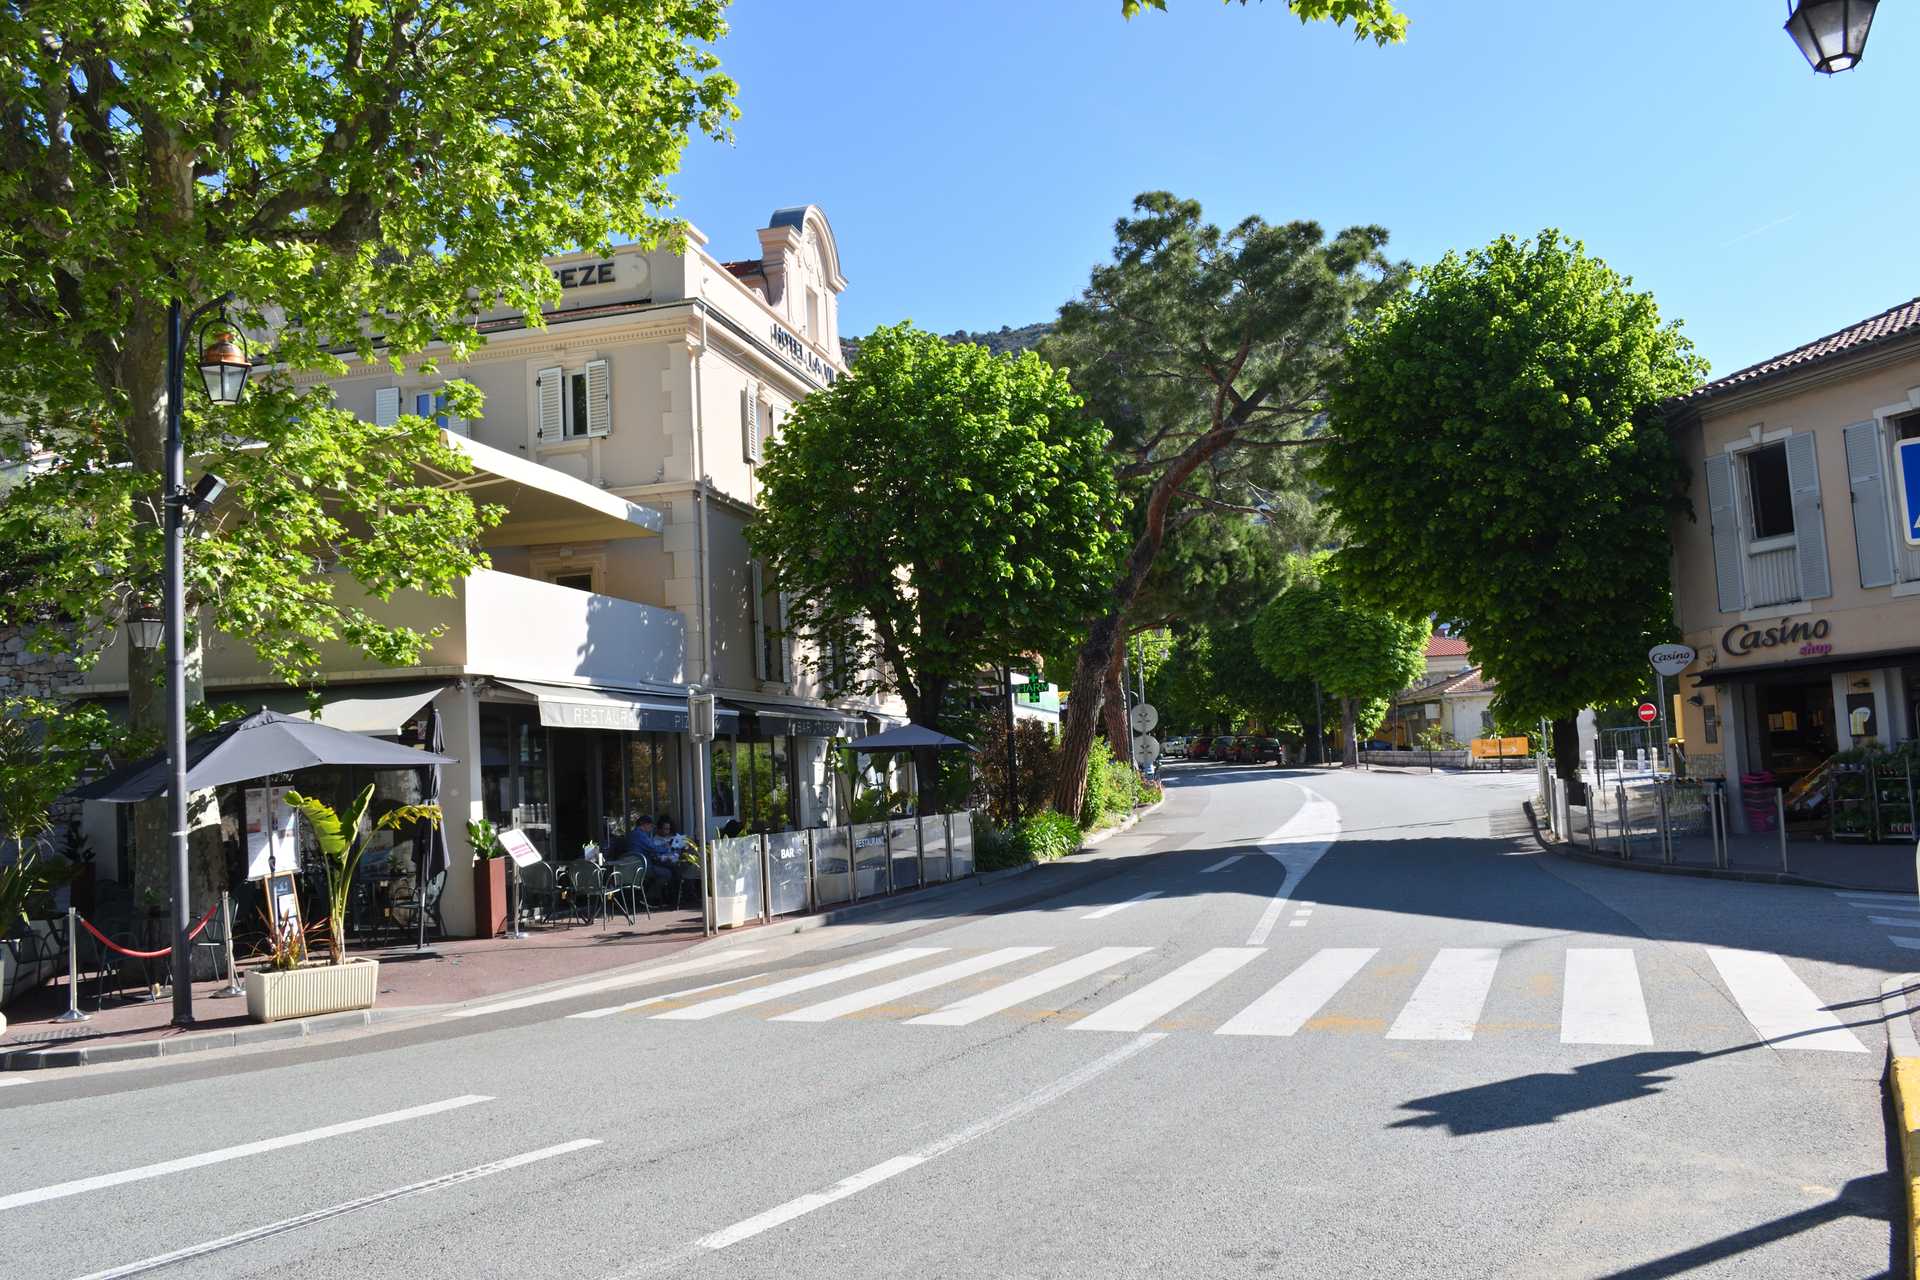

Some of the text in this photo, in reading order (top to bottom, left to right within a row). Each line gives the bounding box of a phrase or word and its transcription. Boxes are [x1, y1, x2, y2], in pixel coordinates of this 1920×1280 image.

[1722, 618, 1829, 656] Casino
[1652, 651, 1690, 664] Casino
[574, 708, 649, 728] RESTAURANT
[780, 848, 794, 859] BAR
